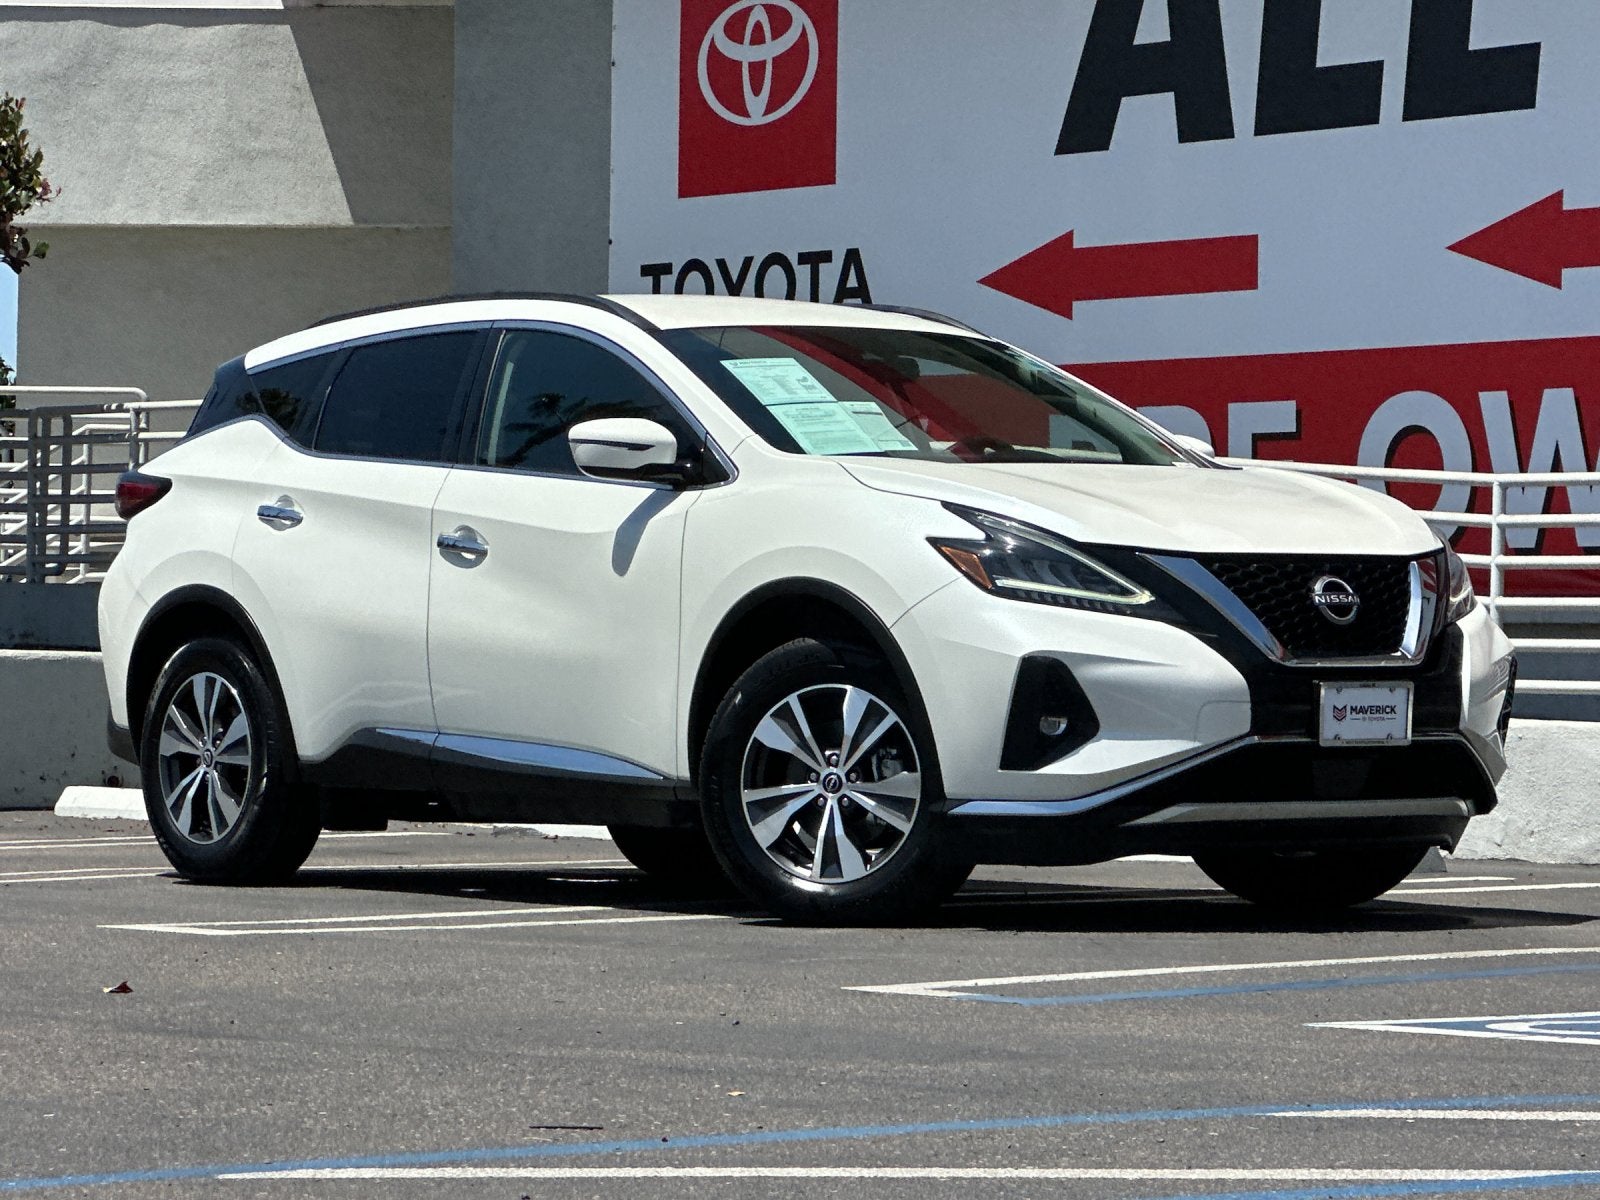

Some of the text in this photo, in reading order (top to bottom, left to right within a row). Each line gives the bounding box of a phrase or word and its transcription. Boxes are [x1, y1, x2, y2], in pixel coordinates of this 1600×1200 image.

[641, 248, 873, 304] TOYOTA
[1315, 595, 1359, 604] NISSAN
[1350, 705, 1397, 715] MAVERICK
